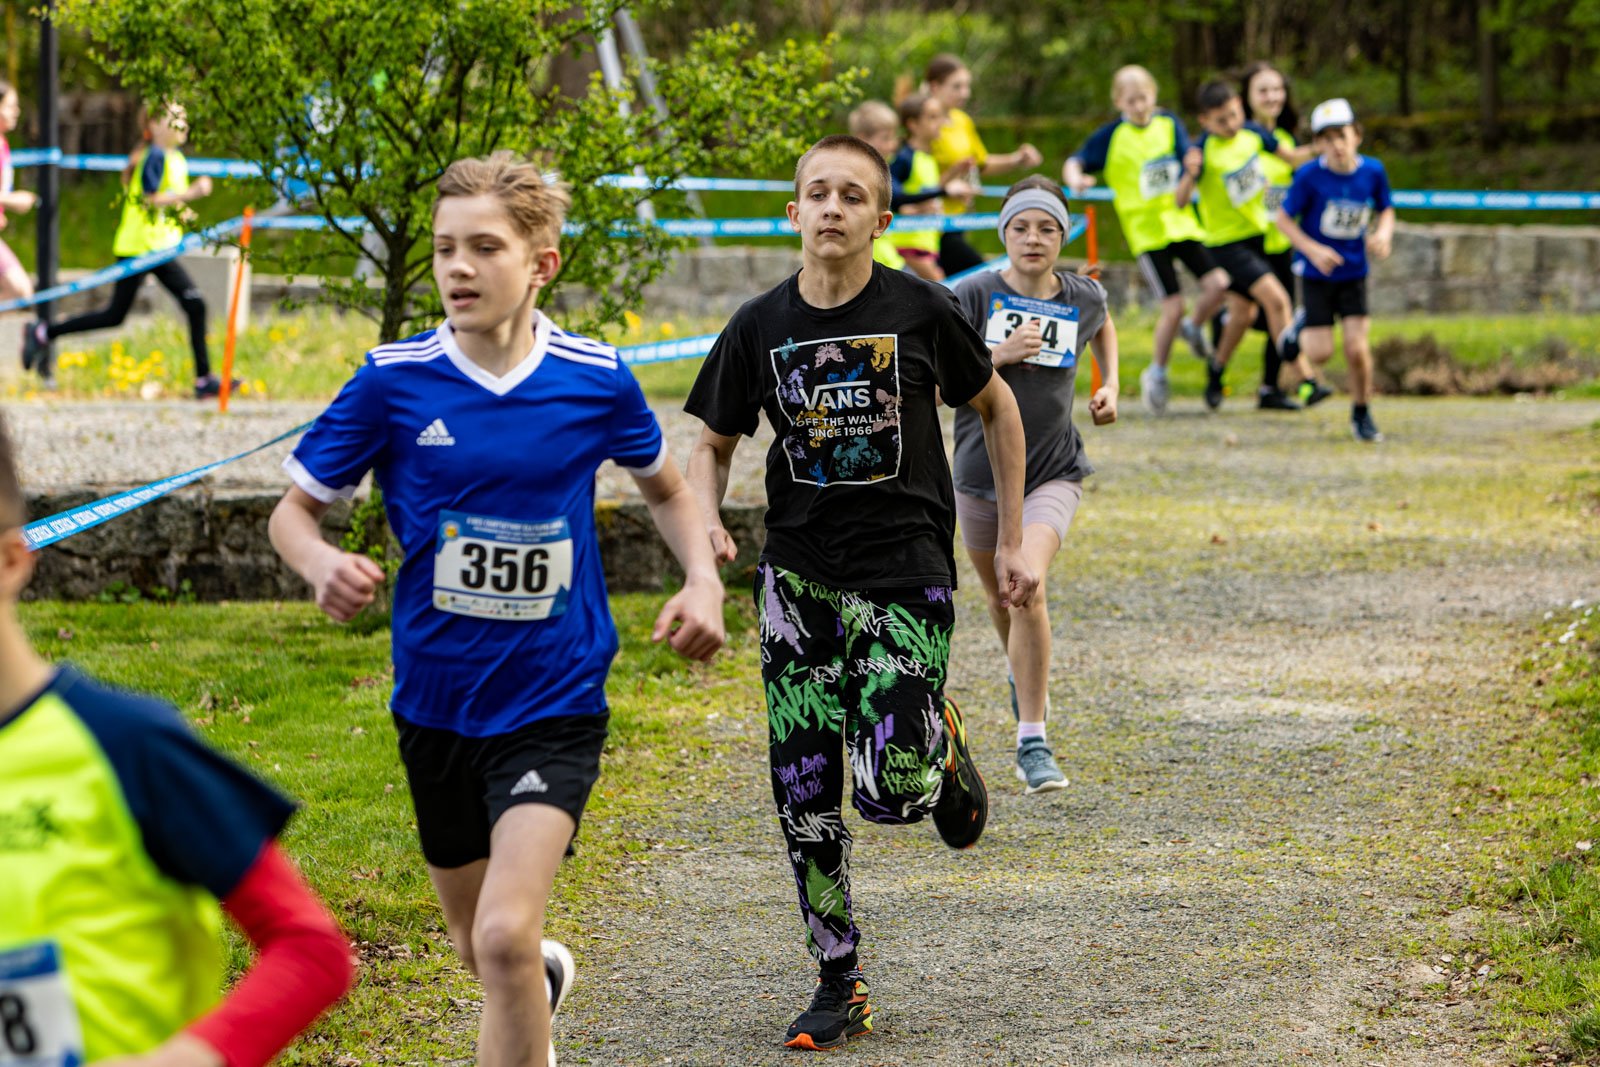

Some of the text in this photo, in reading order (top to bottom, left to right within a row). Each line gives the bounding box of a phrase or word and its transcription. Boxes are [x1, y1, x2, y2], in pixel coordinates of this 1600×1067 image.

[1004, 312, 1059, 349] 34
[798, 380, 871, 411] VANS
[808, 425, 873, 438] SINCE 1966
[822, 416, 845, 427] THE
[461, 543, 549, 593] 356
